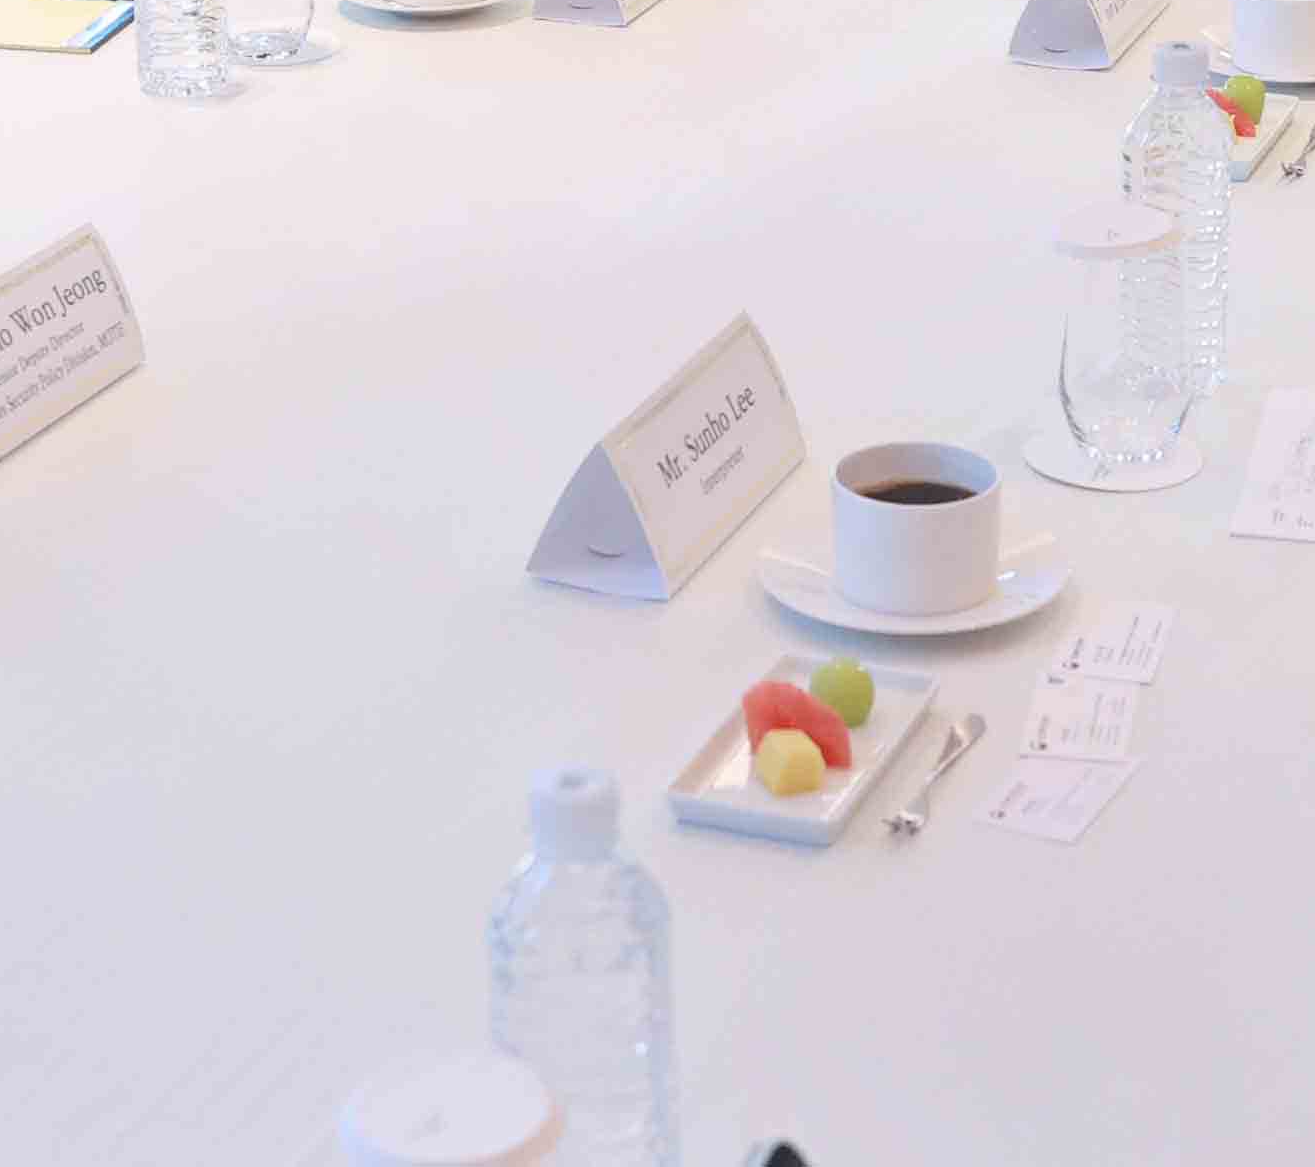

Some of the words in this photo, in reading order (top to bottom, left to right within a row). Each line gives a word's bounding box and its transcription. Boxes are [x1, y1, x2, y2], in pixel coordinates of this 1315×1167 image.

[8, 301, 56, 335] Won
[52, 270, 107, 317] Jeong
[656, 453, 689, 489] Mr.
[684, 411, 731, 462] Sunho
[725, 387, 755, 421] Lee
